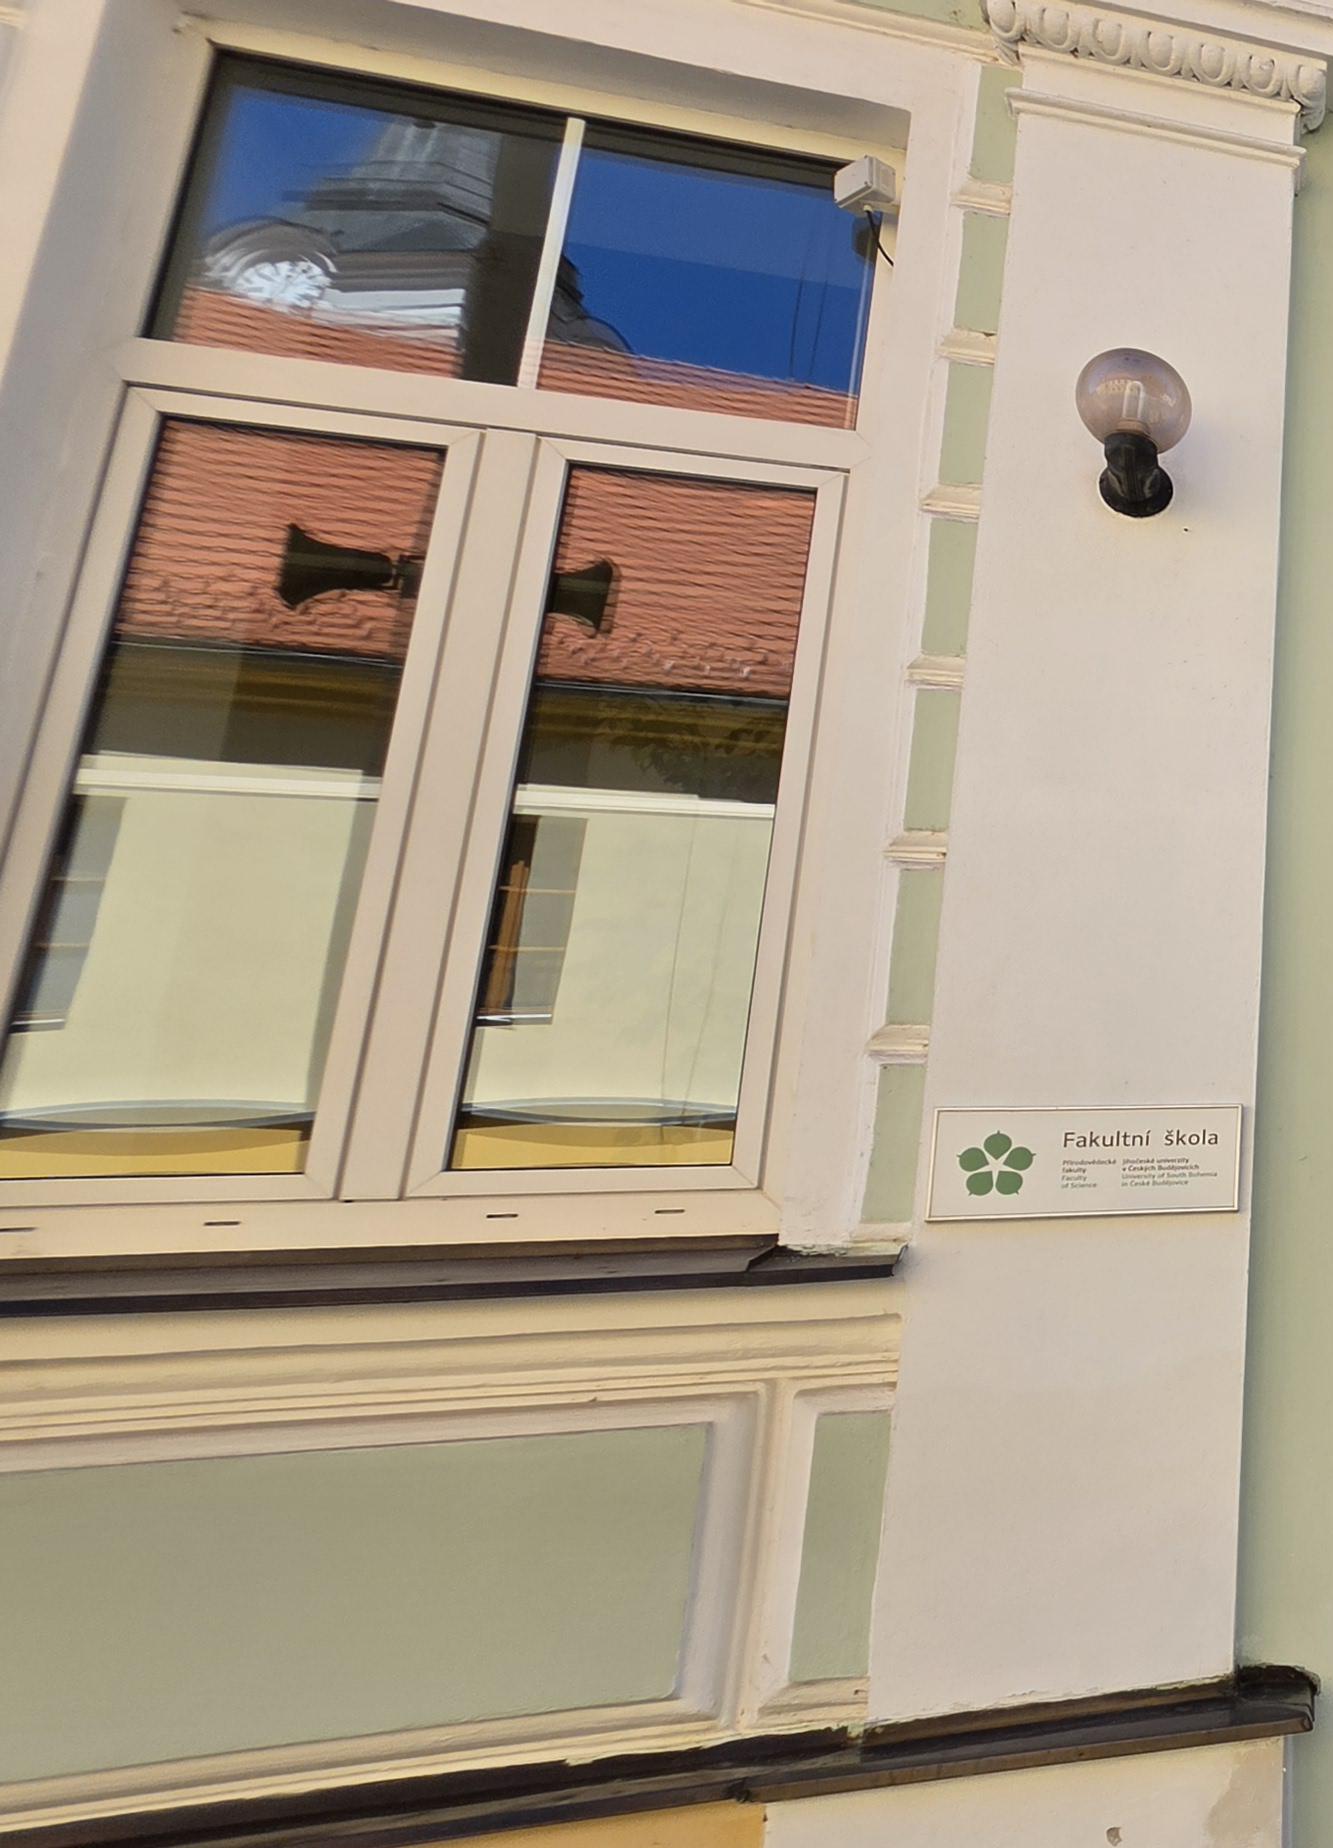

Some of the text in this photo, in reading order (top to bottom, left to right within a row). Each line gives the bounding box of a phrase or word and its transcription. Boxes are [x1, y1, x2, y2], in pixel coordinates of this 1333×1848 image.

[1063, 1129, 1218, 1148] Fakultní škola
[1061, 1174, 1087, 1182] Faculty
[1121, 1173, 1156, 1181] University
